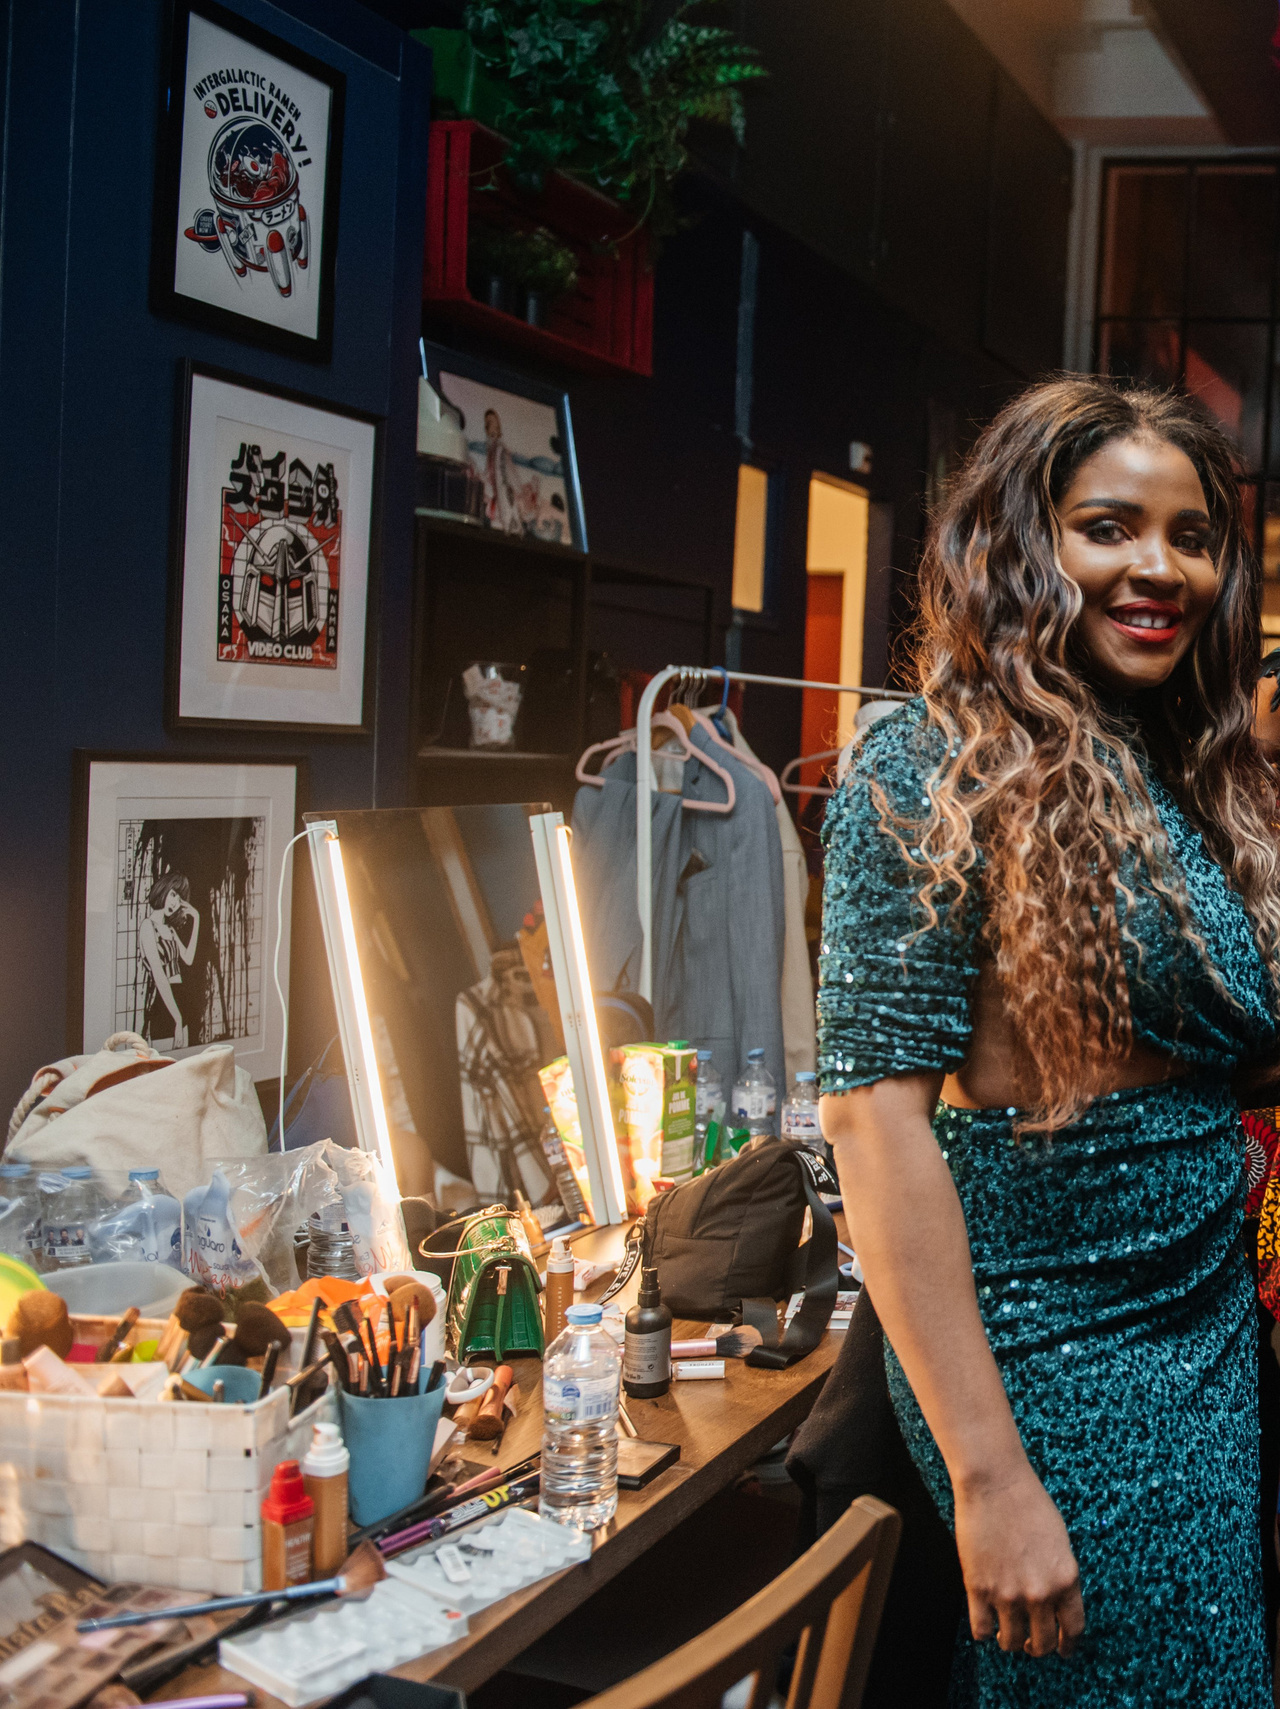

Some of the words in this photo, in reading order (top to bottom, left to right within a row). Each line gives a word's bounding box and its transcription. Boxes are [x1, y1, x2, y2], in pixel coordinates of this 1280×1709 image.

[193, 68, 267, 101] INTERGALACTIC
[269, 82, 302, 122] RAMEN
[265, 202, 293, 224] ラーメン
[221, 579, 231, 638] OSAKA
[328, 593, 337, 648] NAMBA
[247, 641, 283, 657] VIDEO
[284, 644, 313, 660] CLUB
[668, 1098, 691, 1115] POMME
[619, 1250, 637, 1280] LOVE
[480, 1484, 511, 1508] UP
